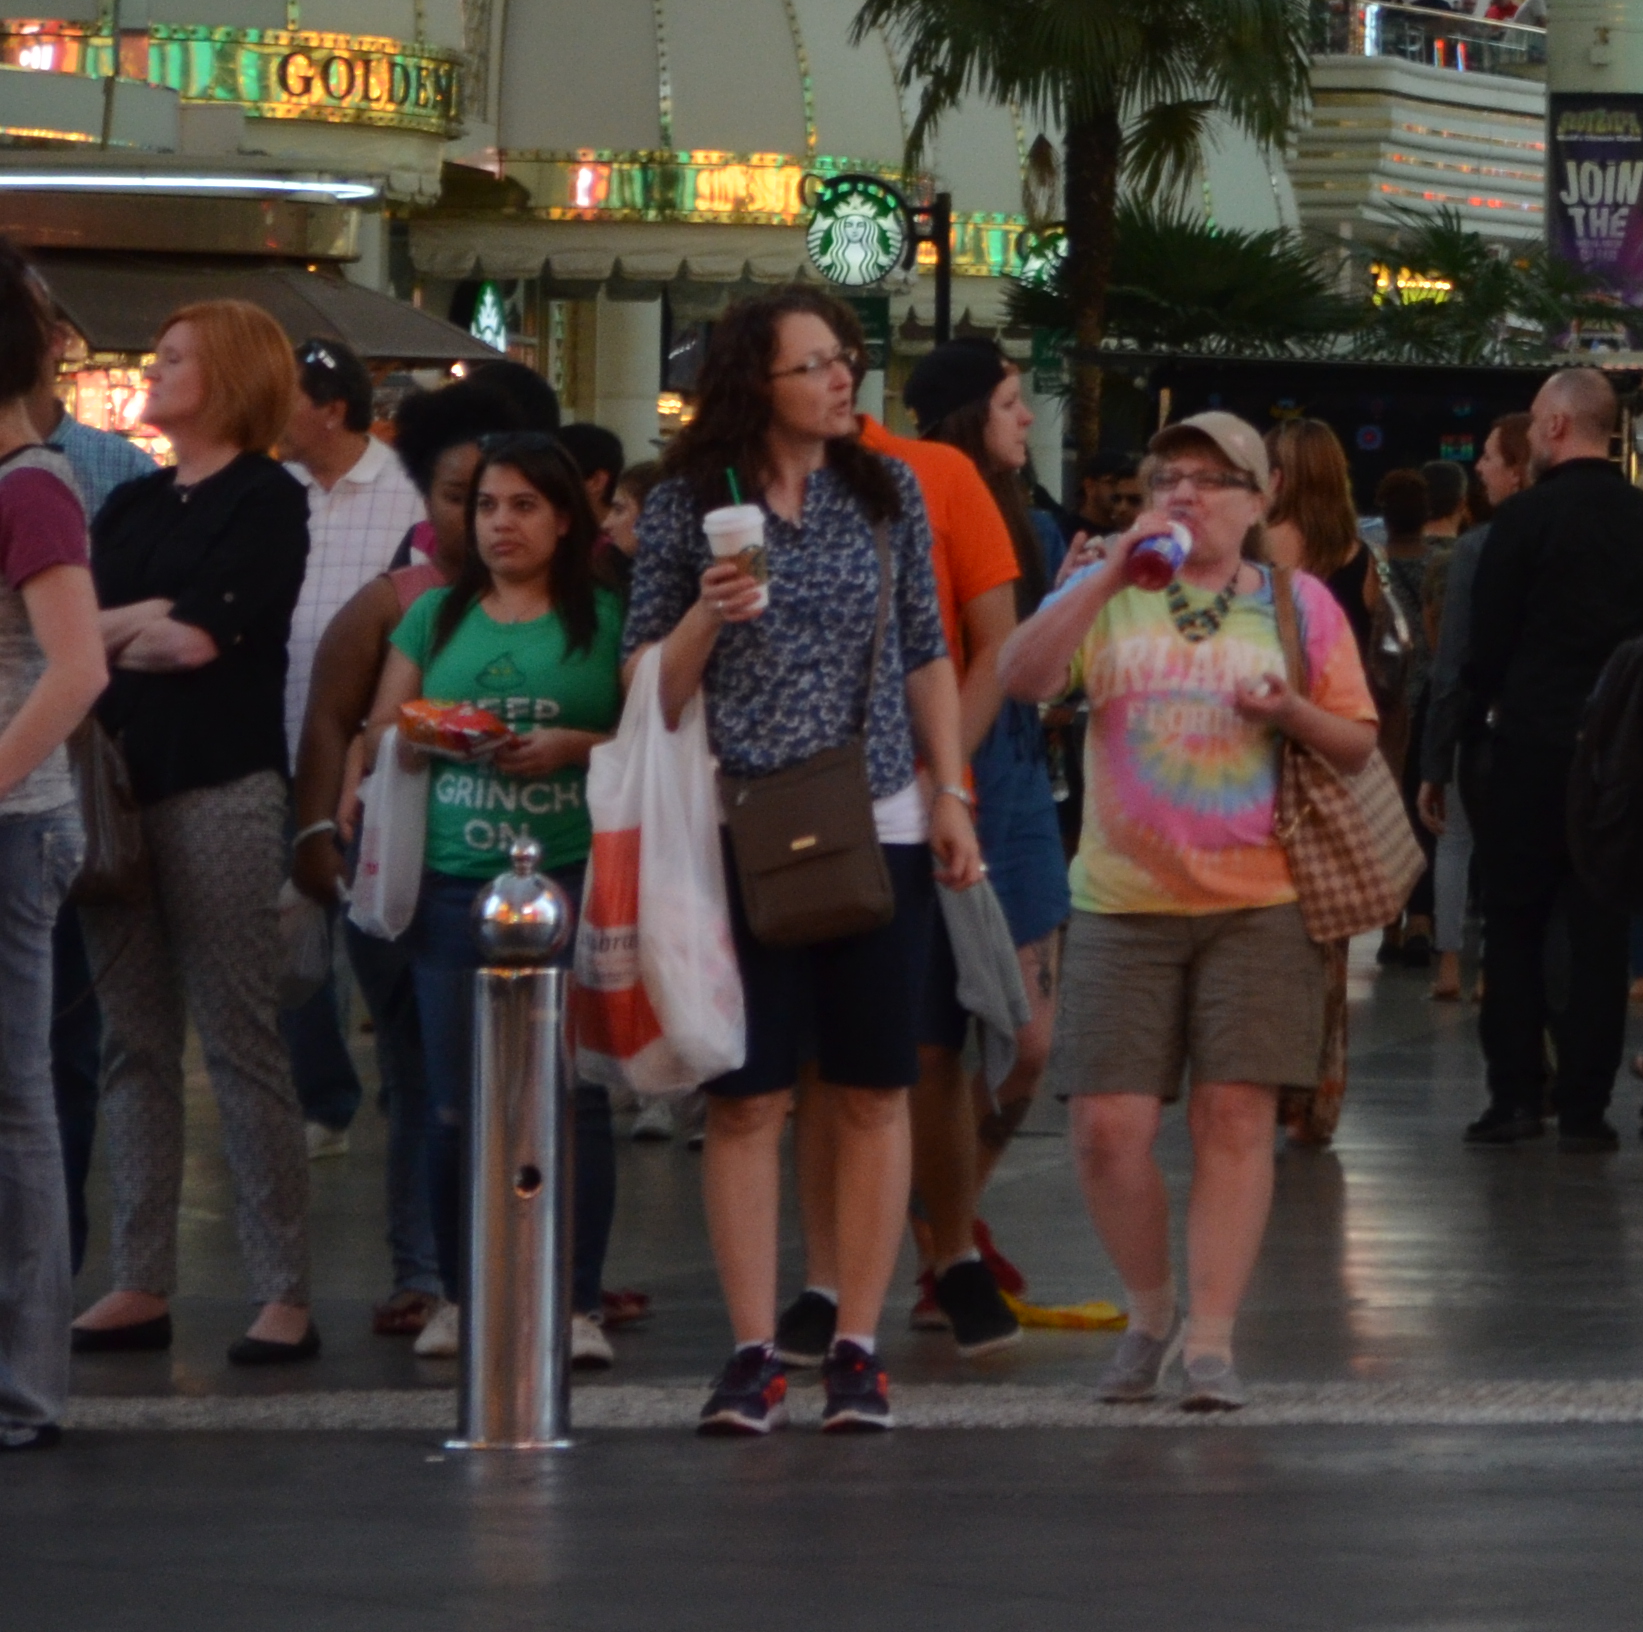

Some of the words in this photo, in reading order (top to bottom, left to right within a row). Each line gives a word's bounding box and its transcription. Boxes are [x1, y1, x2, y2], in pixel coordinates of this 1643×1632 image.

[276, 51, 450, 109] GOLDEN
[1567, 206, 1630, 239] THE
[435, 771, 580, 815] GRINCH
